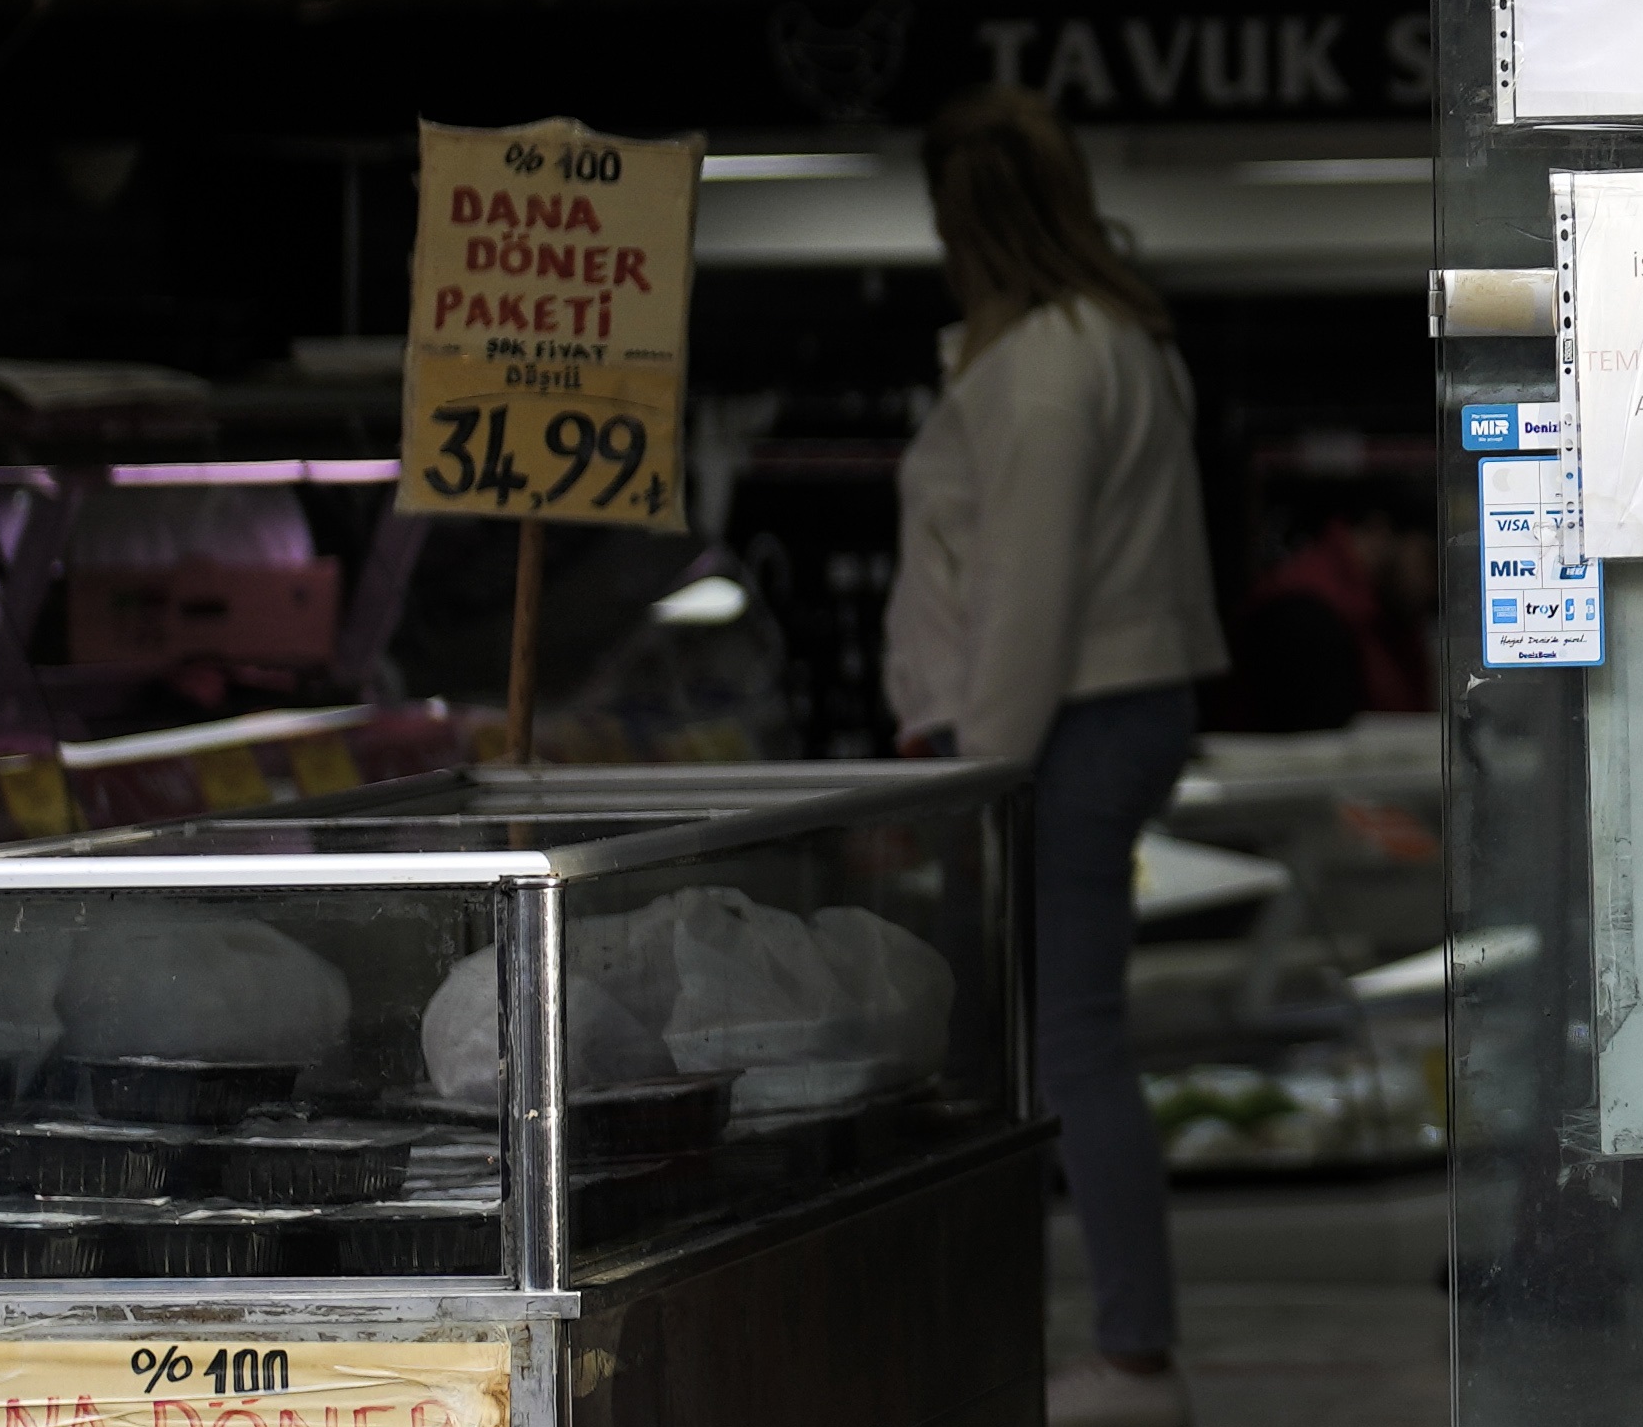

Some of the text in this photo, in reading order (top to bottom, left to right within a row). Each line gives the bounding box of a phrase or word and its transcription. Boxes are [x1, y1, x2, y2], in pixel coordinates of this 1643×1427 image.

[972, 16, 1354, 111] TAVUK
[451, 184, 602, 235] DANA
[466, 230, 652, 295] DÖNER
[435, 283, 613, 340] PAKETİ
[1524, 421, 1560, 434] Deniz
[1496, 519, 1531, 532] VISA
[1490, 560, 1536, 578] MIR
[1525, 602, 1560, 619] troy
